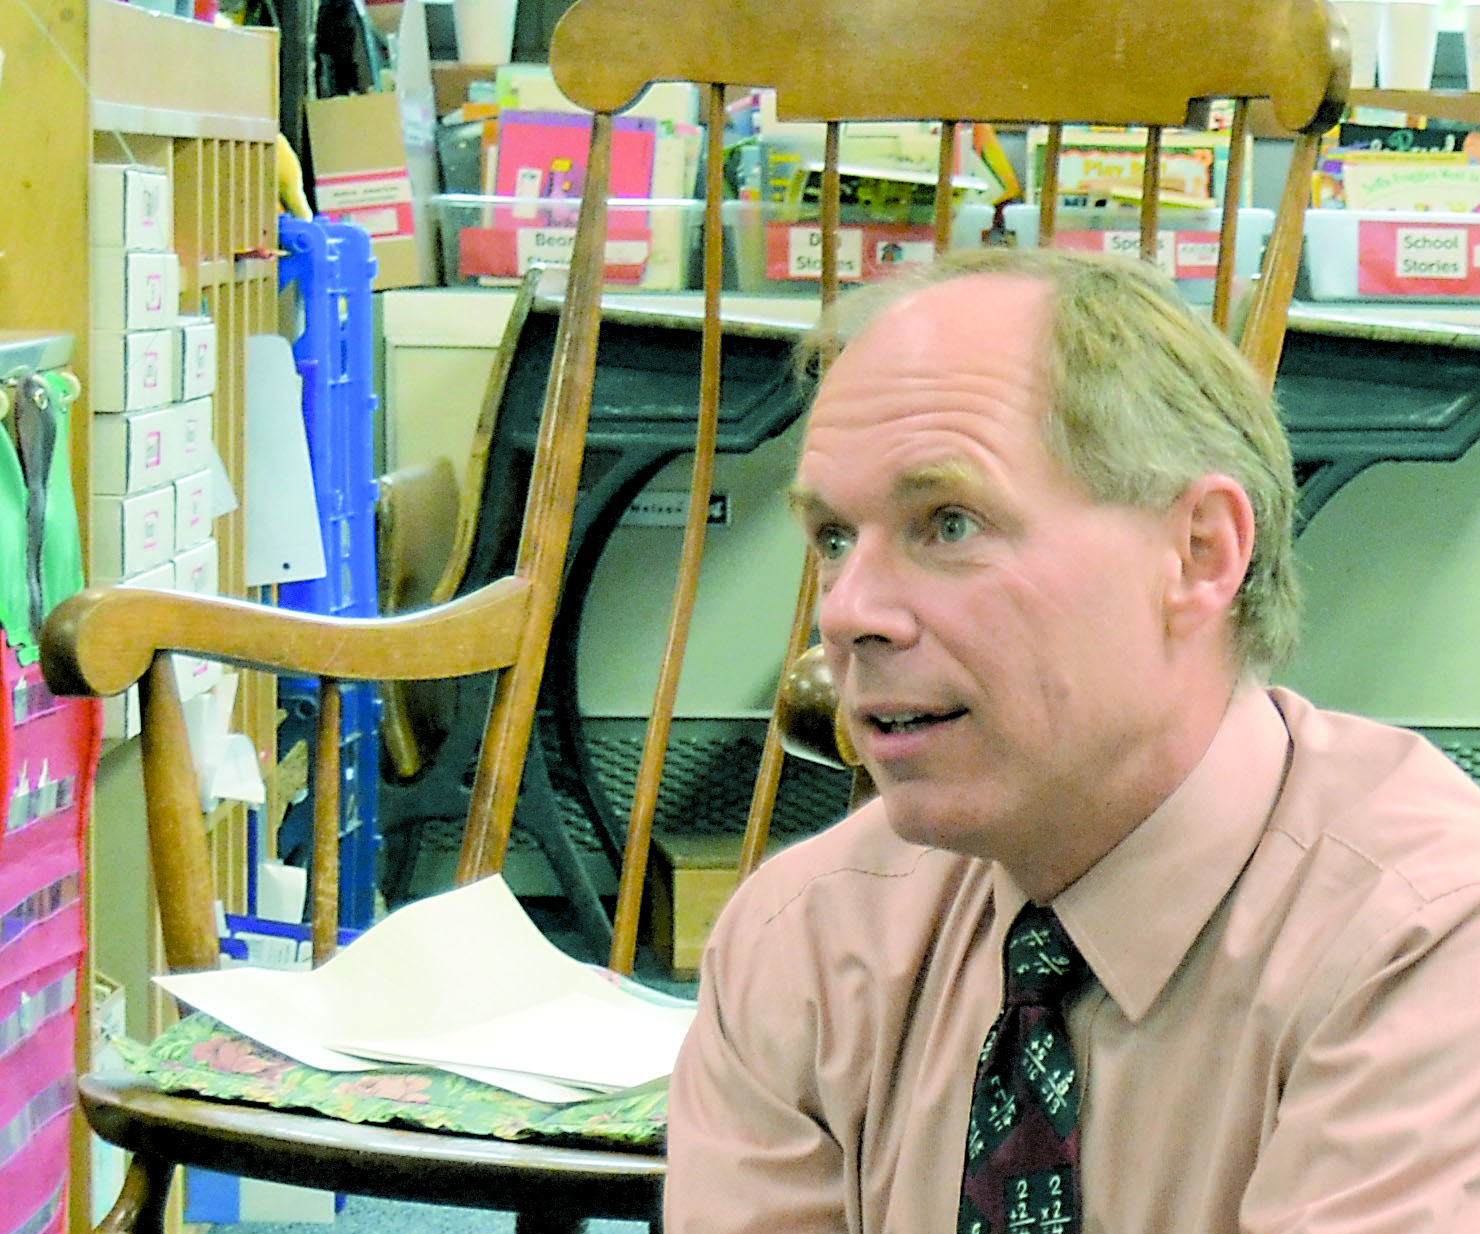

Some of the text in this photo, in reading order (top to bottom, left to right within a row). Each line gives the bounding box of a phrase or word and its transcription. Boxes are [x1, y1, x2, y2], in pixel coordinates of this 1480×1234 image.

[1403, 234, 1460, 250] School
[1402, 258, 1460, 274] Stories
[1016, 1179, 1029, 1200] 2
[1048, 1174, 1063, 1196] 2
